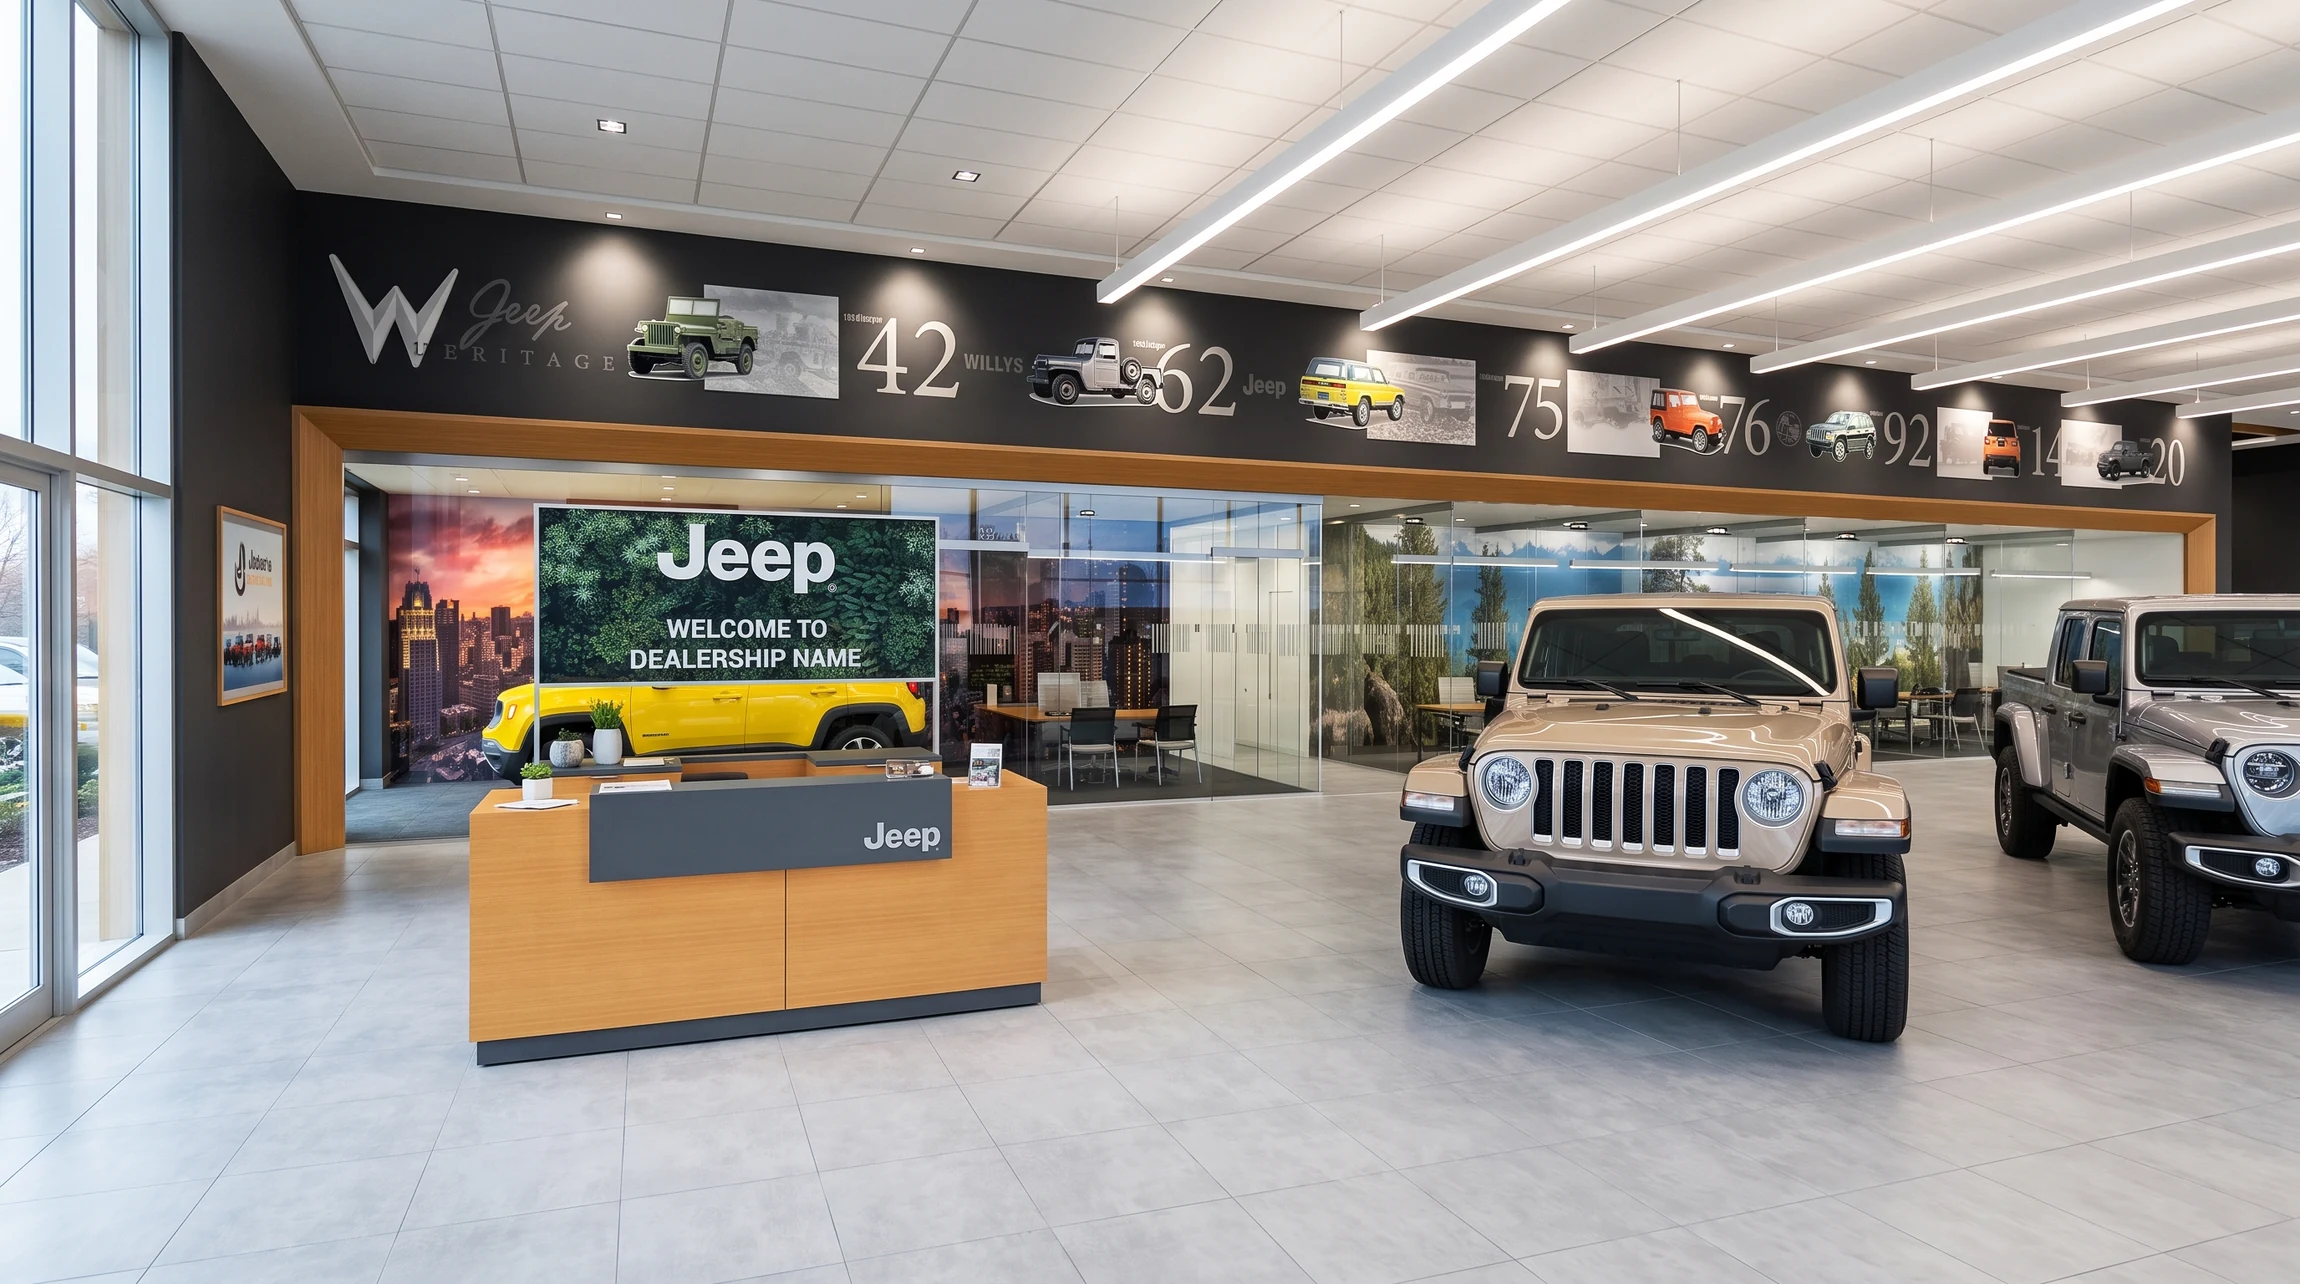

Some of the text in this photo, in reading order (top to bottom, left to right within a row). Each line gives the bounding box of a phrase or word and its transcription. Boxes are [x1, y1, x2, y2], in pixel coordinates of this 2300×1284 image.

[460, 279, 571, 349] Jeep
[857, 317, 960, 398] 42
[964, 353, 1024, 374] WILLYS
[1155, 343, 1236, 416] 62
[1242, 373, 1286, 399] Jeep
[1504, 374, 1563, 440] 75
[1720, 395, 1771, 456] 76
[1884, 411, 1931, 467] 92
[2032, 427, 2062, 477] 14
[2150, 437, 2185, 487] 20
[657, 523, 836, 594] Jeep
[666, 618, 828, 639] WELCOME TO
[630, 648, 862, 670] DEALERSHIP NAME
[863, 822, 941, 852] Jeep
